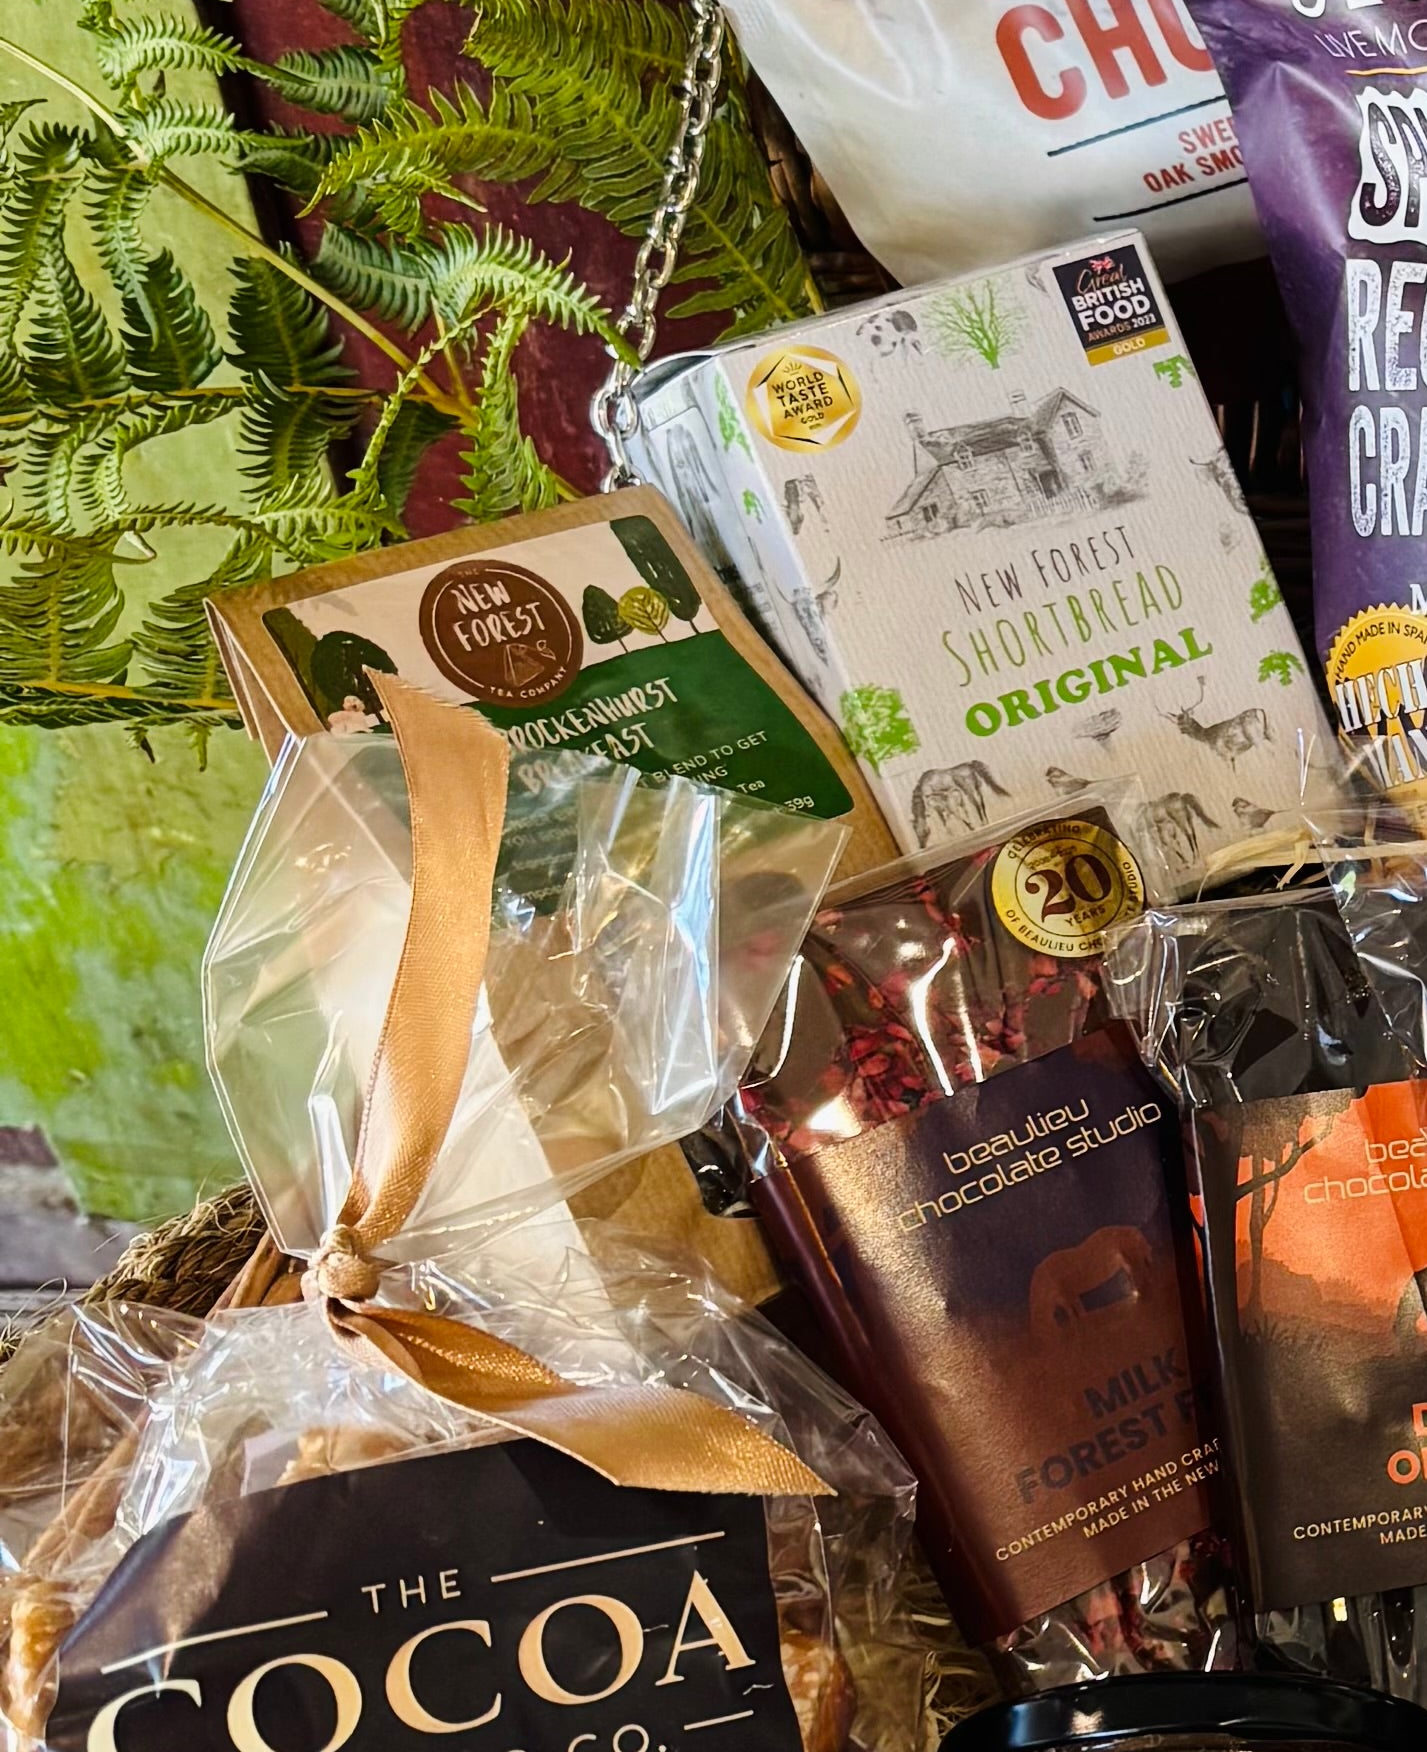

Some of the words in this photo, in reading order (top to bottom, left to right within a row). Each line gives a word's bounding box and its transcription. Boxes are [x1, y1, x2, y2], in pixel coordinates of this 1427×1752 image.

[1070, 281, 1145, 312] BRITISH
[1079, 295, 1151, 332] FOOD
[771, 372, 825, 395] WORLD
[777, 383, 829, 408] TASTE
[782, 395, 834, 420] AWARD
[955, 565, 1022, 617] NEW
[1033, 526, 1139, 588] FOREST
[453, 581, 510, 615] NEW
[453, 600, 547, 653] FOREST
[942, 564, 1184, 688] SHORTBREAD
[489, 686, 515, 700] TEA
[518, 667, 567, 700] COMPANY
[964, 628, 1212, 738] ORIGINAL
[941, 1096, 1092, 1176] beaulieu
[896, 1154, 1068, 1232] chocolate
[1069, 1099, 1163, 1161] studio
[995, 1480, 1128, 1563] CONTEMPORARY
[1132, 1456, 1186, 1494] HAND
